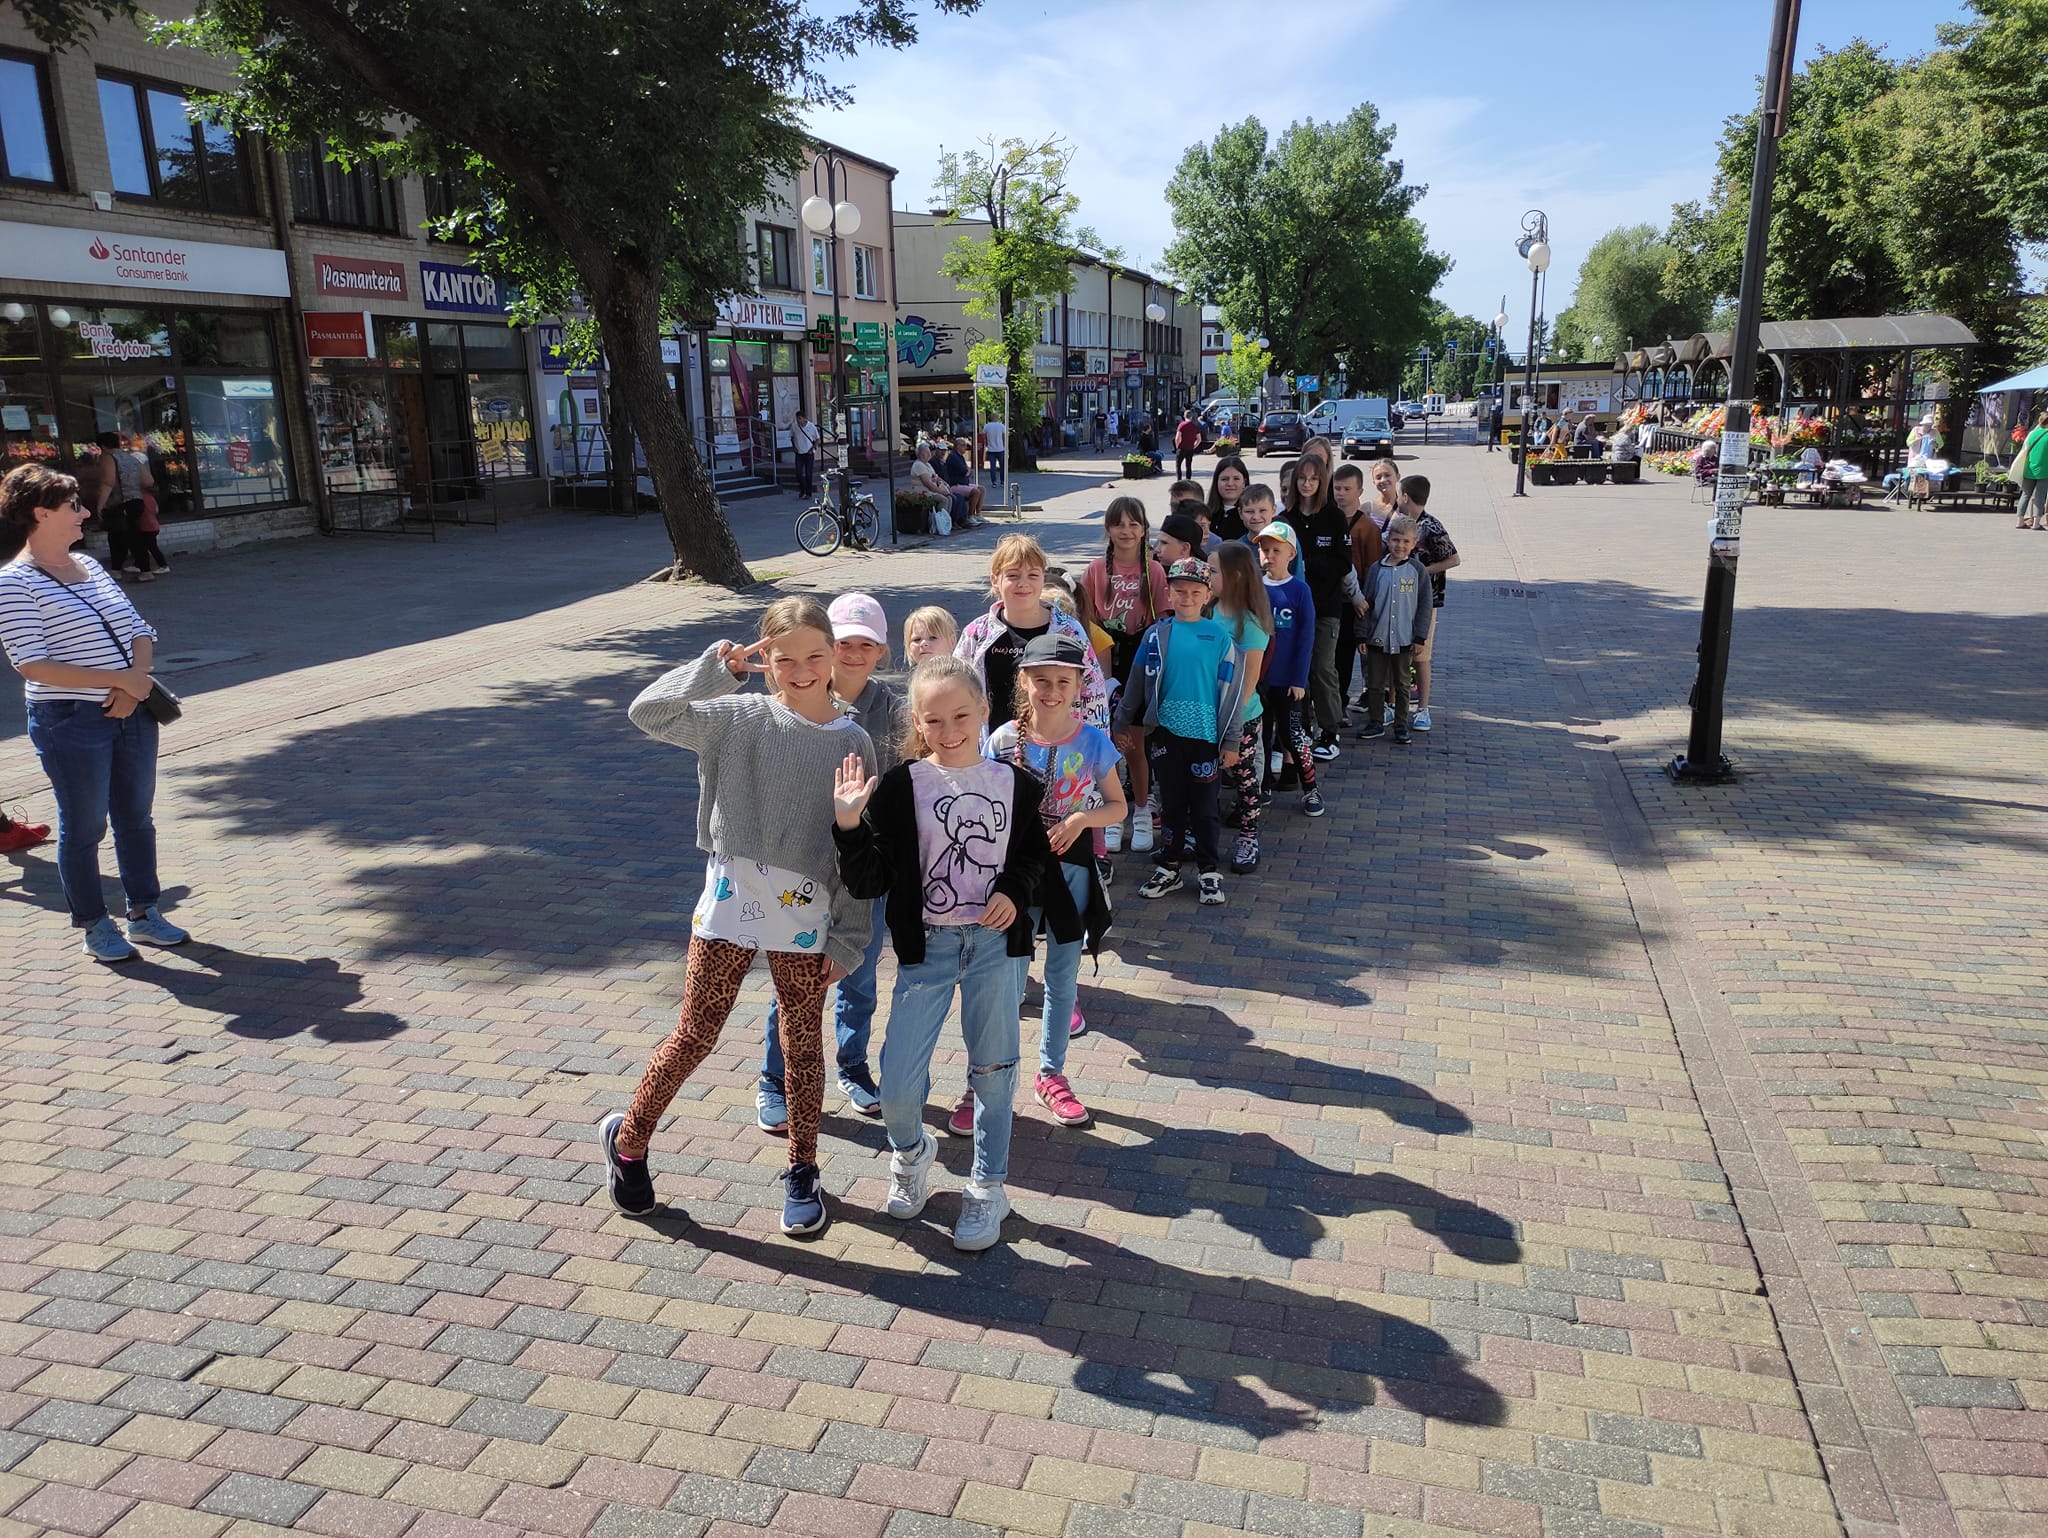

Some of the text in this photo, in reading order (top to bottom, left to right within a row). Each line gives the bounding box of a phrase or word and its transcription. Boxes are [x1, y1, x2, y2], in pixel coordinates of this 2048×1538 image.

[112, 244, 186, 266] Santander
[116, 265, 189, 282] Consumer Bank
[322, 263, 401, 293] Pasmanteria
[422, 269, 498, 306] KANTOR
[742, 303, 784, 326] APTEKA
[80, 321, 113, 339] Bank
[92, 339, 151, 359] Kredytów
[1110, 573, 1140, 592] Force
[1103, 592, 1135, 621] You
